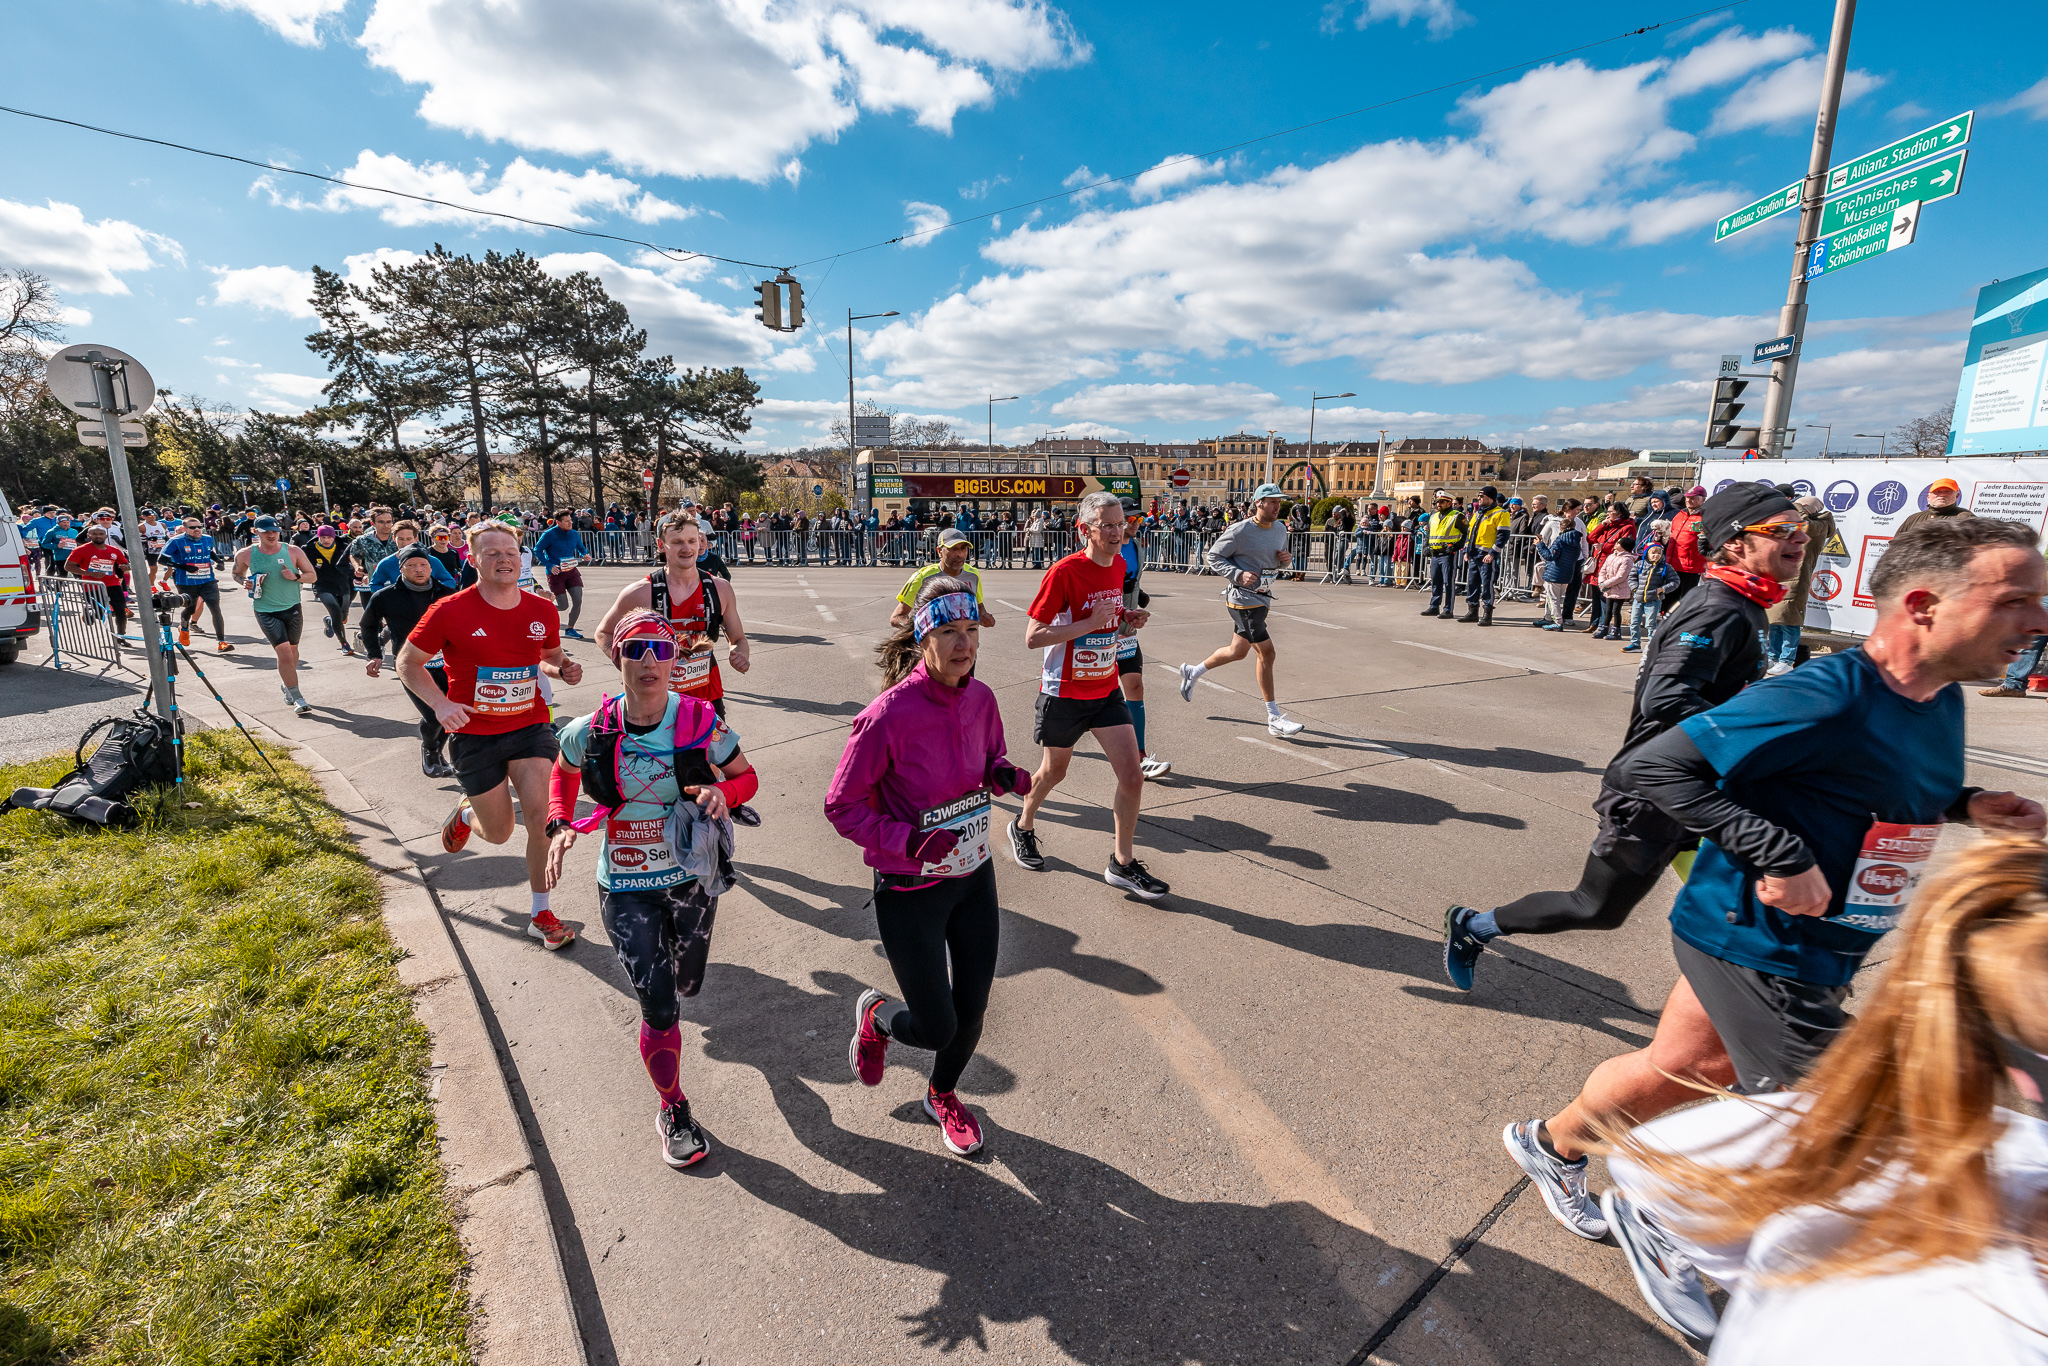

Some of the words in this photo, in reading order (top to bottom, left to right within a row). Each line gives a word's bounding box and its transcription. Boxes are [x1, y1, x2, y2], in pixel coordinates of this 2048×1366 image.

[1850, 155, 1887, 180] Allianz
[1891, 135, 1938, 164] Stadion
[1835, 176, 1918, 215] Technisches
[1731, 211, 1755, 230] Allianz
[1755, 198, 1784, 218] Stadion
[1843, 198, 1900, 225] Museum
[1832, 220, 1888, 252] Schloßallee
[1828, 238, 1886, 269] Schönbrunn
[1808, 265, 1824, 279] 570m
[1722, 360, 1739, 371] BUS
[954, 479, 1046, 494] BIGBUS.COM
[2001, 508, 2043, 516] hingewiesen
[1086, 637, 1111, 646] ERSTE
[1077, 653, 1097, 661] Hervis
[687, 661, 708, 675] Daniel
[1087, 669, 1102, 677] WIEN
[492, 671, 522, 680] ERSTE
[480, 686, 505, 696] Hervis
[511, 686, 532, 697] Sam
[511, 702, 533, 712] ENERGIE
[923, 791, 988, 826] POWERADE
[613, 850, 644, 863] Hervis
[614, 870, 684, 890] SPARKASSE
